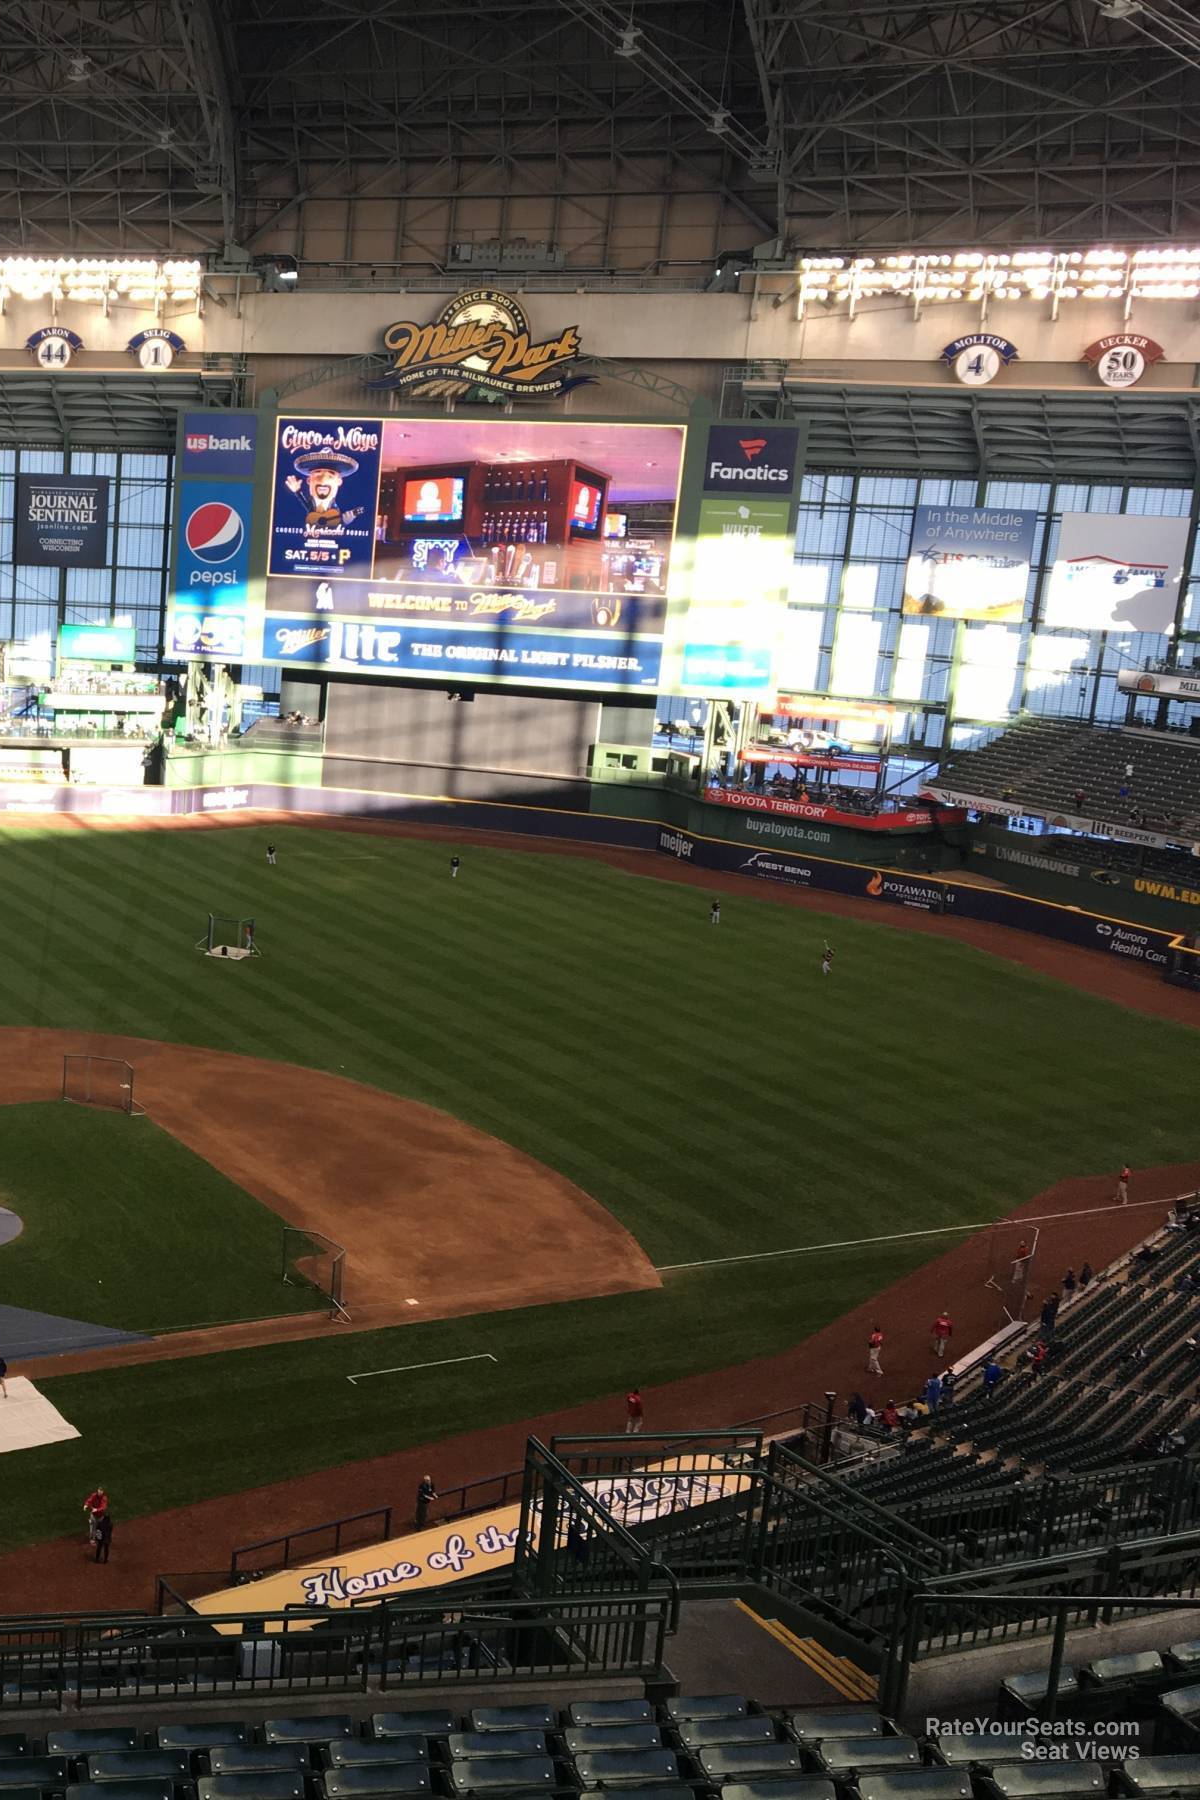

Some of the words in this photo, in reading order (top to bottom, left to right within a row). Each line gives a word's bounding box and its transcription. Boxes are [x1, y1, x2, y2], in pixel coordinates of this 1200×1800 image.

[452, 292, 487, 311] SINCE
[491, 293, 514, 310] 2001
[40, 329, 69, 338] AARON
[143, 330, 170, 339] SELIG
[954, 335, 1007, 351] MOLITOR
[1099, 335, 1149, 349] UECKER
[41, 343, 67, 363] 44
[151, 346, 163, 366] 1
[384, 318, 507, 370] Miller
[477, 325, 582, 382] Park
[967, 353, 984, 376] 4
[1107, 351, 1137, 371] 50
[400, 370, 425, 385] HOME
[427, 368, 439, 377] OF
[441, 368, 459, 376] THE
[462, 370, 515, 391] MILWAUKEE
[516, 380, 562, 393] BREWERS
[282, 425, 323, 453] Cinco
[323, 435, 334, 445] de
[333, 426, 378, 452] Mayo
[710, 462, 789, 482] Fanatics
[28, 495, 98, 509] JOURNAL
[28, 509, 97, 523] SENTINEL
[927, 510, 941, 522] In
[945, 511, 969, 523] the
[973, 512, 1024, 526] Middle
[37, 523, 88, 531] jsonline.com
[926, 525, 942, 537] of
[944, 526, 1020, 541] Anywhere
[285, 549, 309, 561] SAT,
[309, 551, 329, 561] 5/5
[190, 570, 238, 587] pepsi
[368, 593, 451, 612] WELCOME
[456, 600, 468, 610] TO
[275, 628, 331, 654] Miller
[411, 643, 442, 658] THE
[446, 646, 518, 662] ORIGINAL
[522, 650, 570, 666] LIGHT
[572, 653, 643, 671] PILSNER.
[726, 793, 767, 808] TOYOTA
[770, 800, 828, 818] TERRITORY
[746, 817, 831, 843] buyatoyota.com
[660, 832, 694, 857] meijer
[757, 860, 784, 871] WEST
[784, 866, 812, 877] BEND
[1113, 928, 1148, 944] Aurora
[1110, 940, 1144, 957] Health
[1145, 949, 1168, 963] Care
[302, 1562, 422, 1606] Home
[427, 1535, 474, 1571] of
